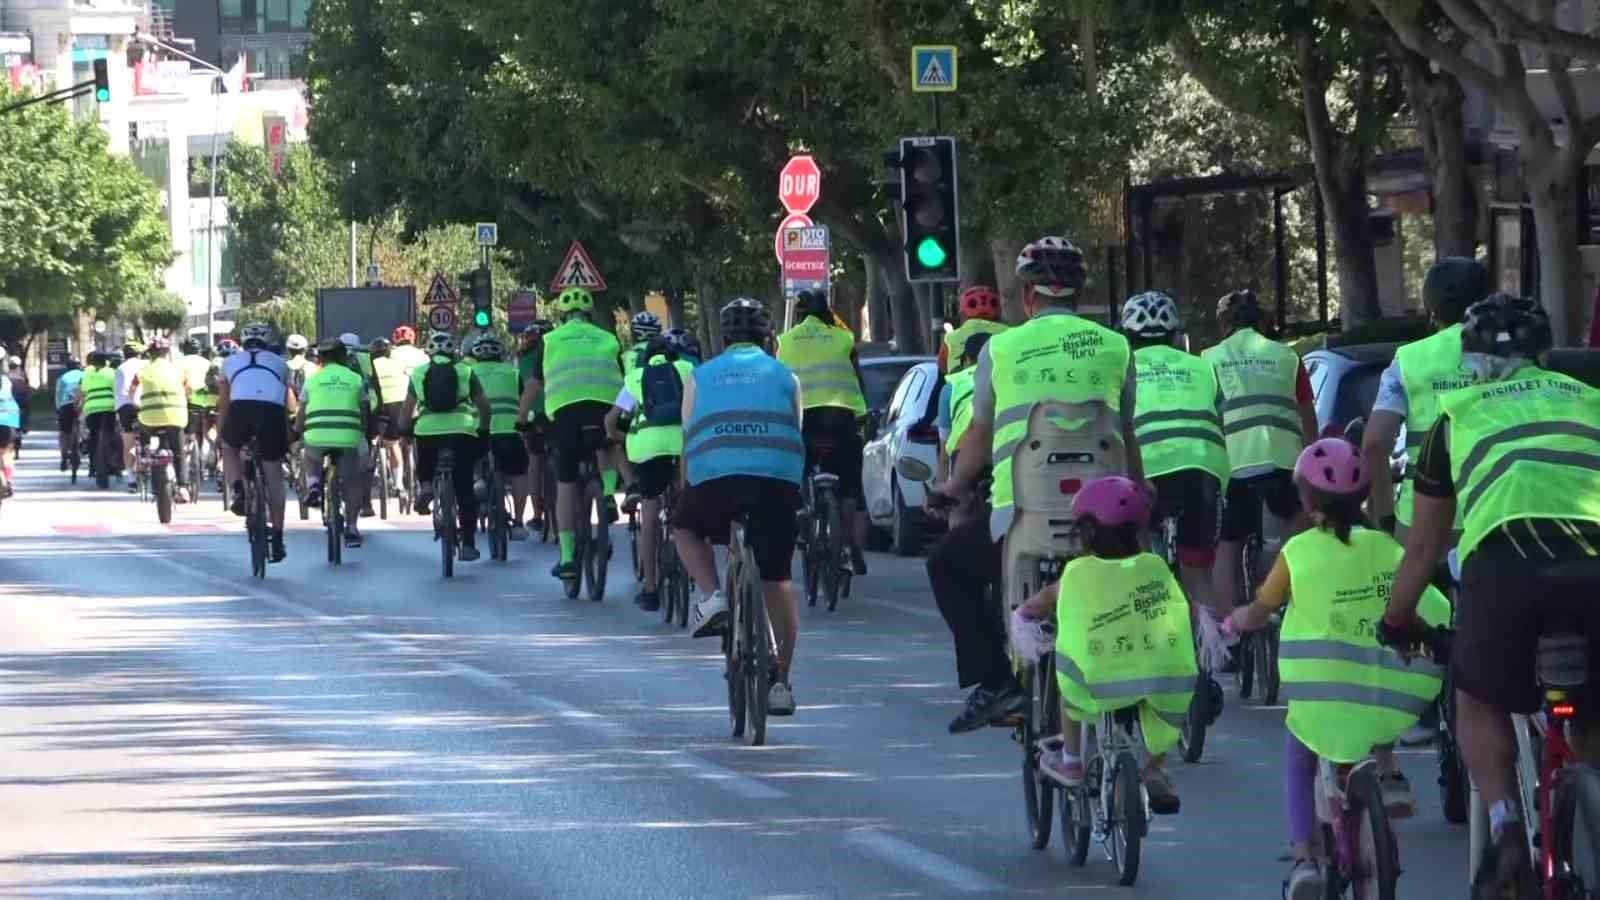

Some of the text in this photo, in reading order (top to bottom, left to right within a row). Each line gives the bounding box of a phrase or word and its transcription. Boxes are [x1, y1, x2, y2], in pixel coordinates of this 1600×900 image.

[783, 174, 817, 197] DUR
[802, 229, 825, 239] OTO
[802, 239, 825, 248] PARK
[434, 312, 450, 324] 30
